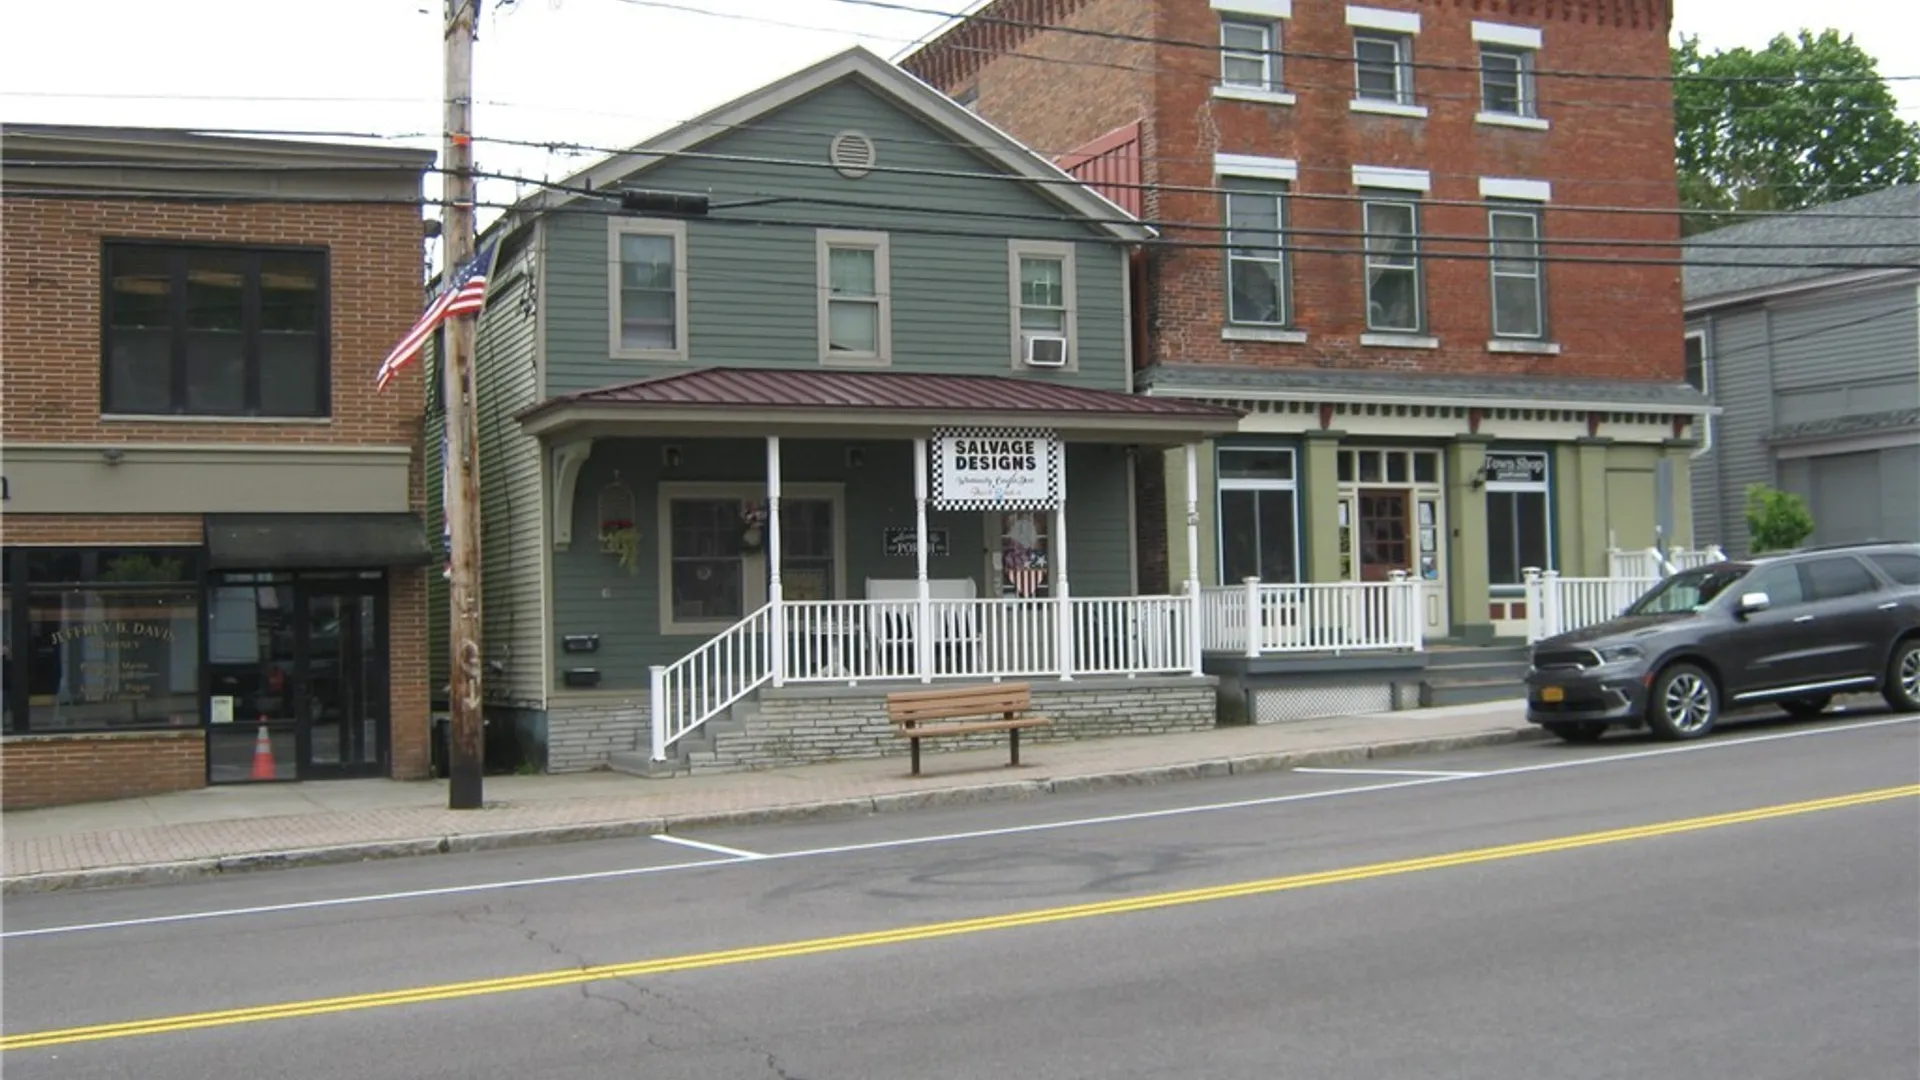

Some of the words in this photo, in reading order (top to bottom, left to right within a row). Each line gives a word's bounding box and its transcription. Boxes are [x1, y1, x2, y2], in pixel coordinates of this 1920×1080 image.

[955, 440, 1035, 455] SALVAGE
[955, 456, 1037, 471] DESIGNS
[1516, 456, 1544, 474] Shop
[51, 622, 112, 646] JEFFREY
[133, 621, 176, 643] DAVIS
